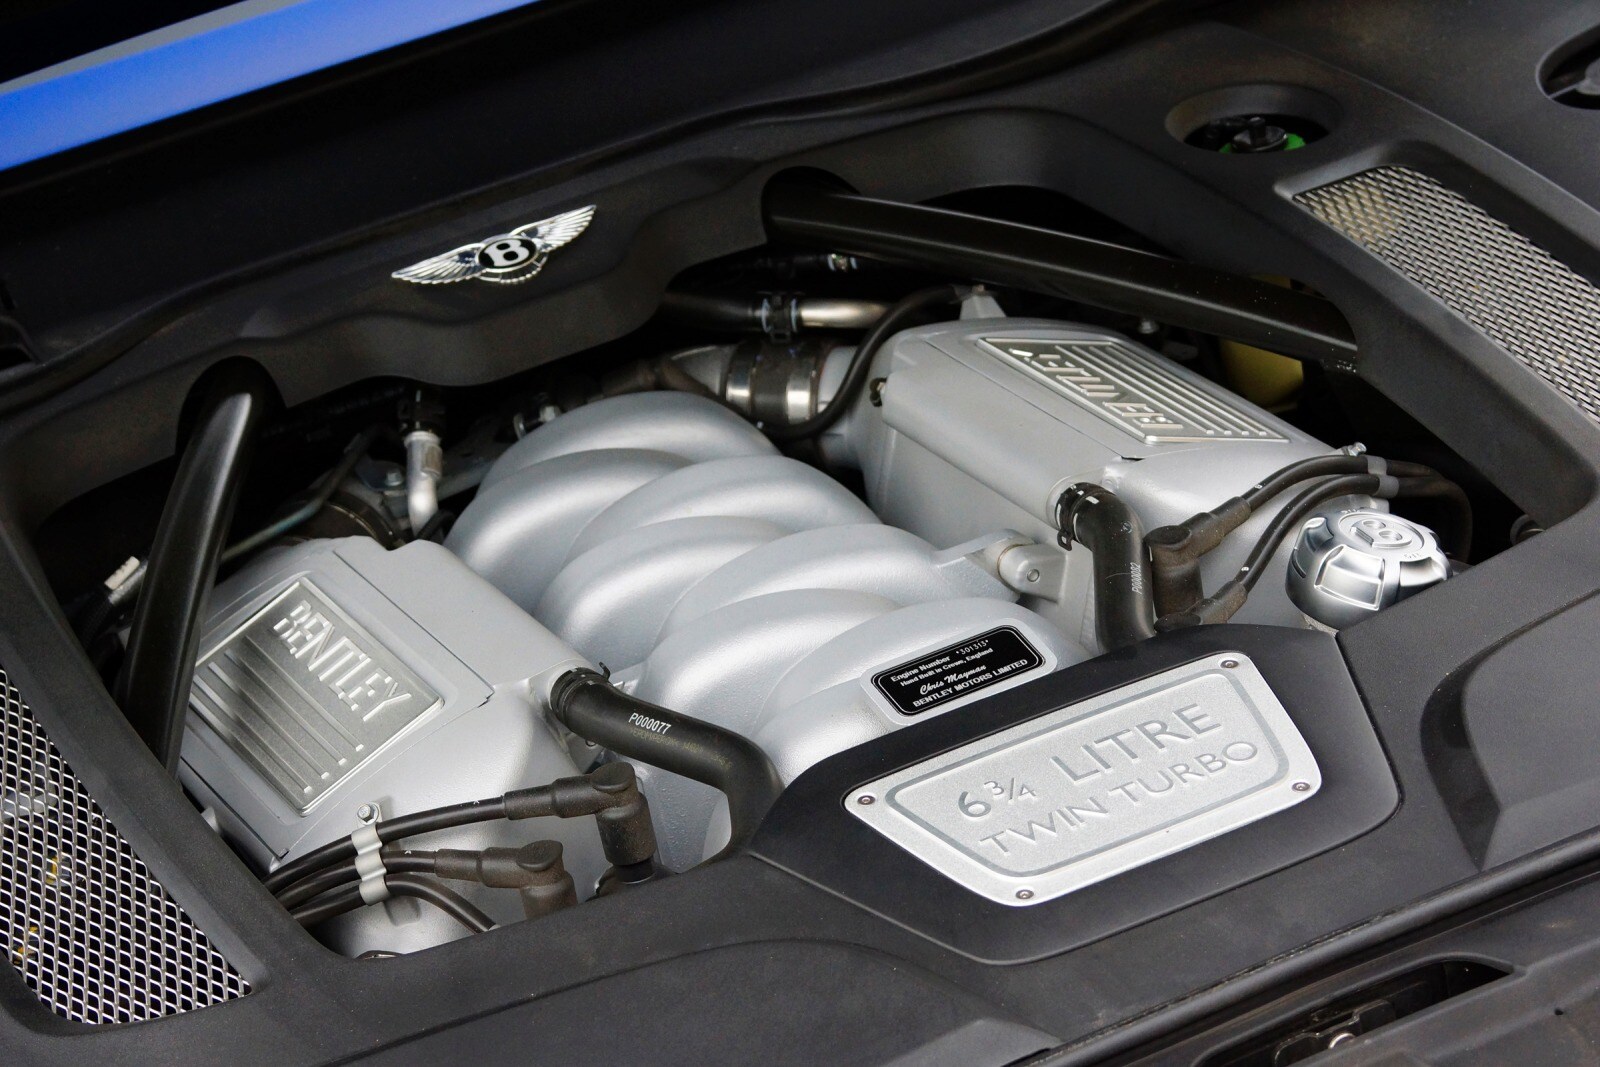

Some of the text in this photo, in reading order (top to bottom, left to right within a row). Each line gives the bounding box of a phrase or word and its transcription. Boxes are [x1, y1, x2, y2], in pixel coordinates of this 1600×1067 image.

[273, 600, 412, 722] BENTLEY
[890, 668, 919, 682] Engine
[918, 656, 950, 671] Number
[900, 676, 919, 687] Hand
[918, 670, 936, 680] Built
[965, 647, 994, 661] England
[912, 658, 1029, 708] BENTLEY MOTORS LIMITED
[919, 680, 945, 695] Chris
[628, 712, 672, 735] P000077
[1050, 702, 1222, 783] LITRE
[978, 740, 1259, 855] TWIN TURBO
